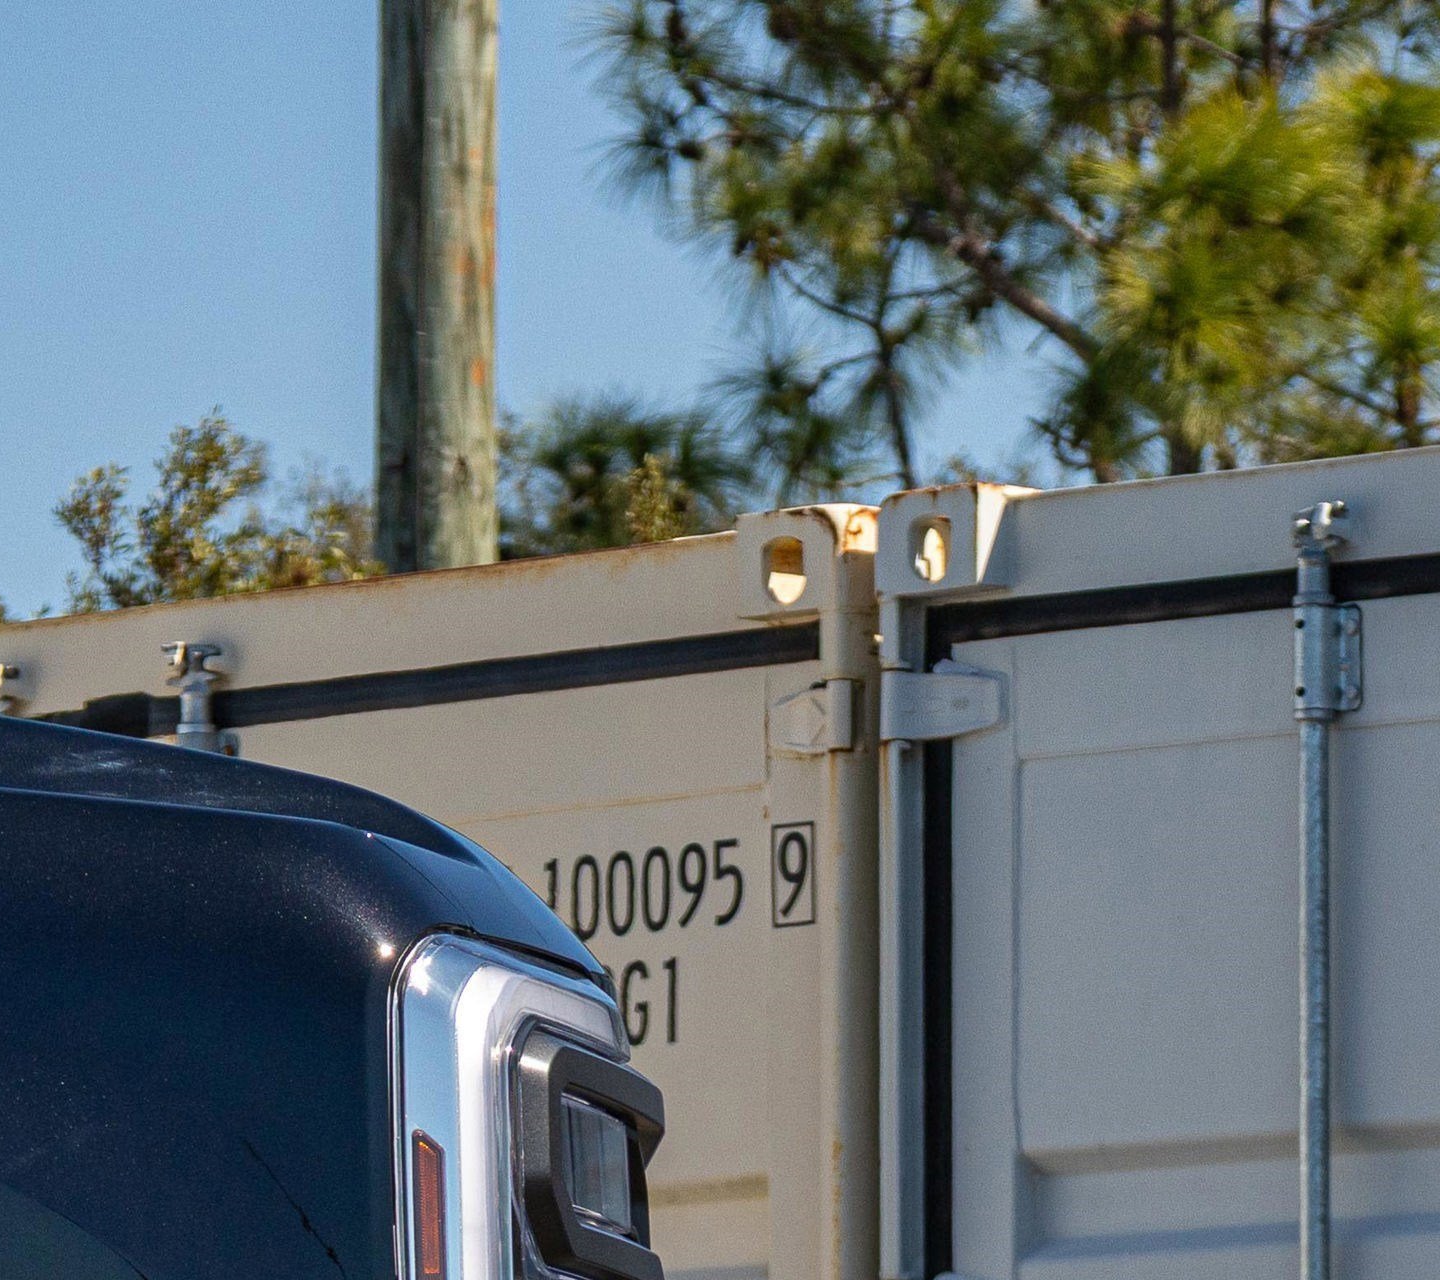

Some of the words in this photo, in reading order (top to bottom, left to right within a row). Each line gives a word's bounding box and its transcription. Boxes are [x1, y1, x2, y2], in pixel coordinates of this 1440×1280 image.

[544, 838, 744, 941] 100095
[778, 828, 808, 920] 9
[609, 956, 678, 1046] G1
